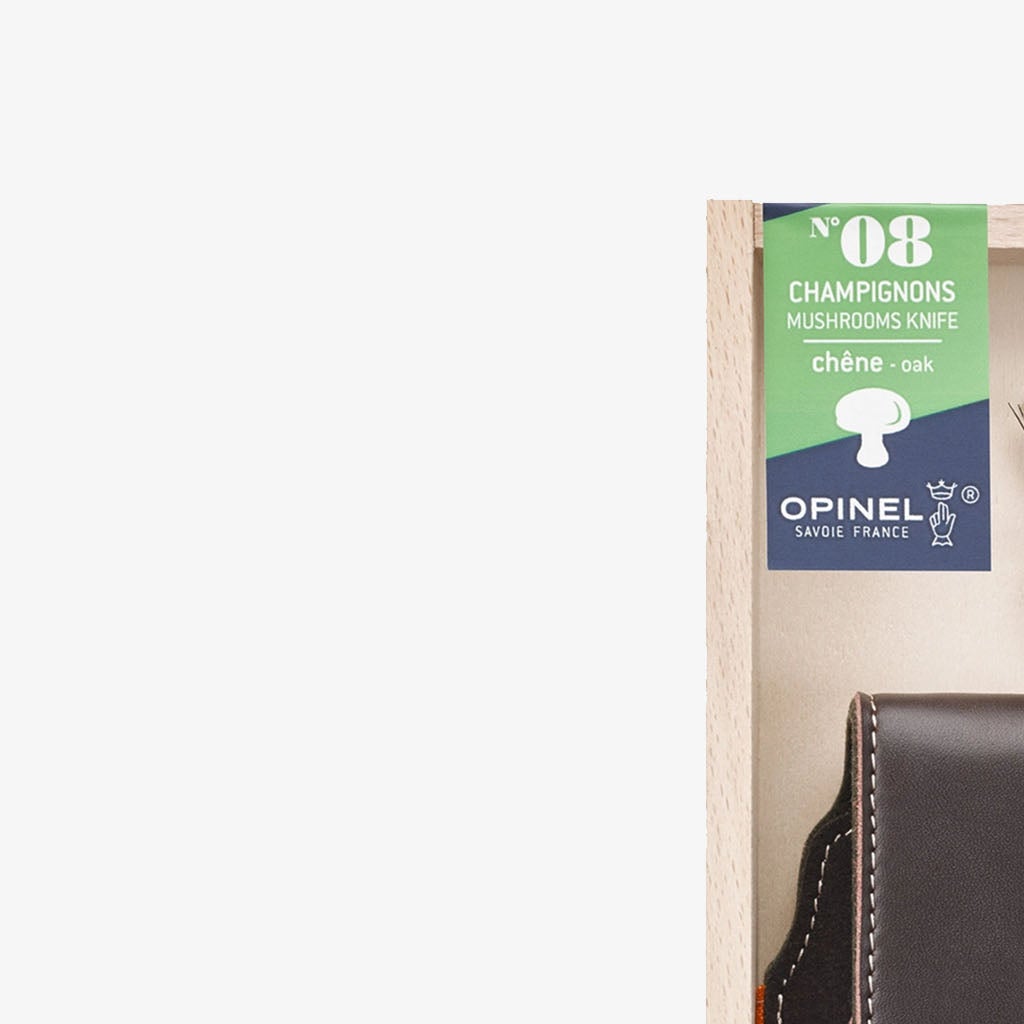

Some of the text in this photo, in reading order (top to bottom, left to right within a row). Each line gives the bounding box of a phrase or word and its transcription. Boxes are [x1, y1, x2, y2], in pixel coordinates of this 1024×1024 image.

[789, 280, 956, 303] CHAMPIGNONS
[787, 311, 959, 330] MUSHROOMS KNIFE
[812, 350, 884, 373] chêne
[901, 355, 934, 373] oak
[780, 496, 924, 521] OPINEL
[795, 525, 909, 539] SAVOIE FRANCE
